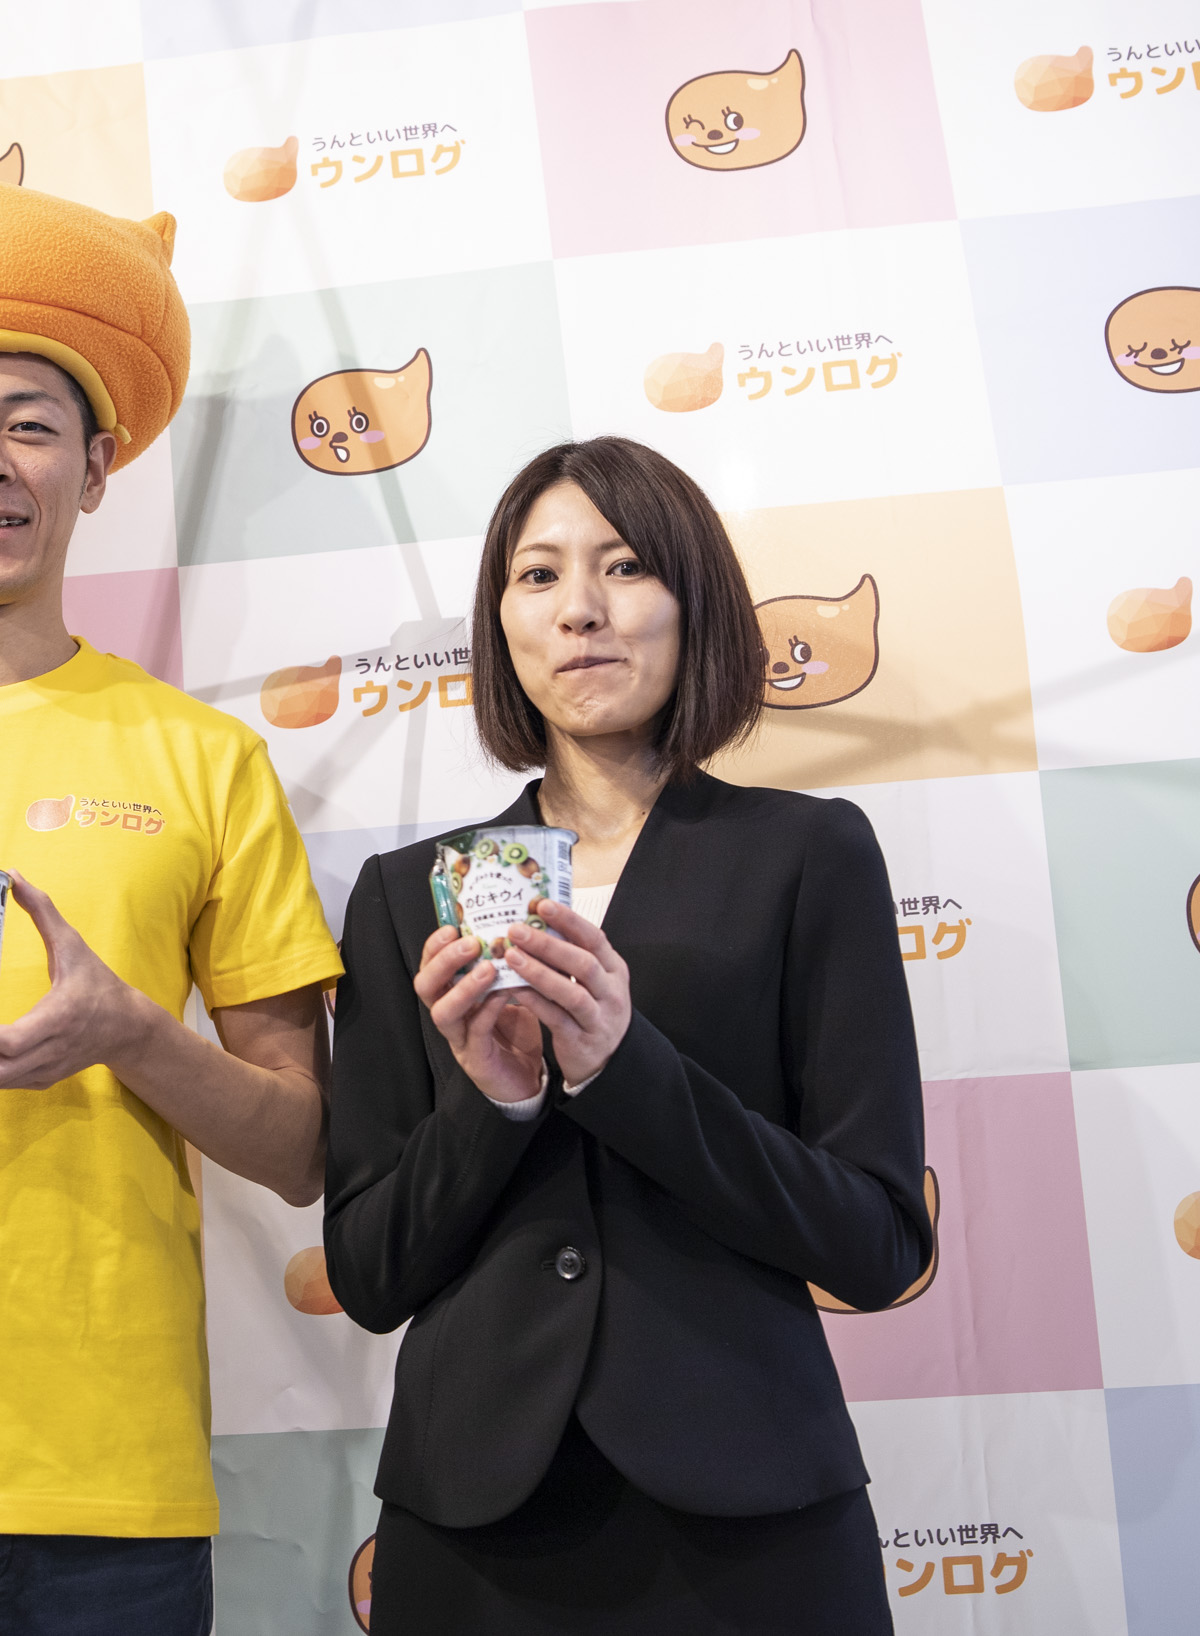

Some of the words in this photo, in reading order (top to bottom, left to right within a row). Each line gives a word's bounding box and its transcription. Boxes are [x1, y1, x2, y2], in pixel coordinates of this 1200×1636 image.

[1107, 39, 1200, 62] うんといい
[312, 122, 457, 151] うんといい世界へ
[311, 139, 466, 188] ウンログ
[738, 332, 893, 360] うんといい世界へ
[737, 352, 903, 401] ウンログ
[355, 647, 471, 674] うんといい世
[353, 673, 474, 717] ウンロ
[80, 798, 162, 816] うんといい世界へ
[76, 808, 166, 835] ウンログ
[466, 888, 523, 908] のむキウイ
[896, 1549, 1034, 1597] ンログ
